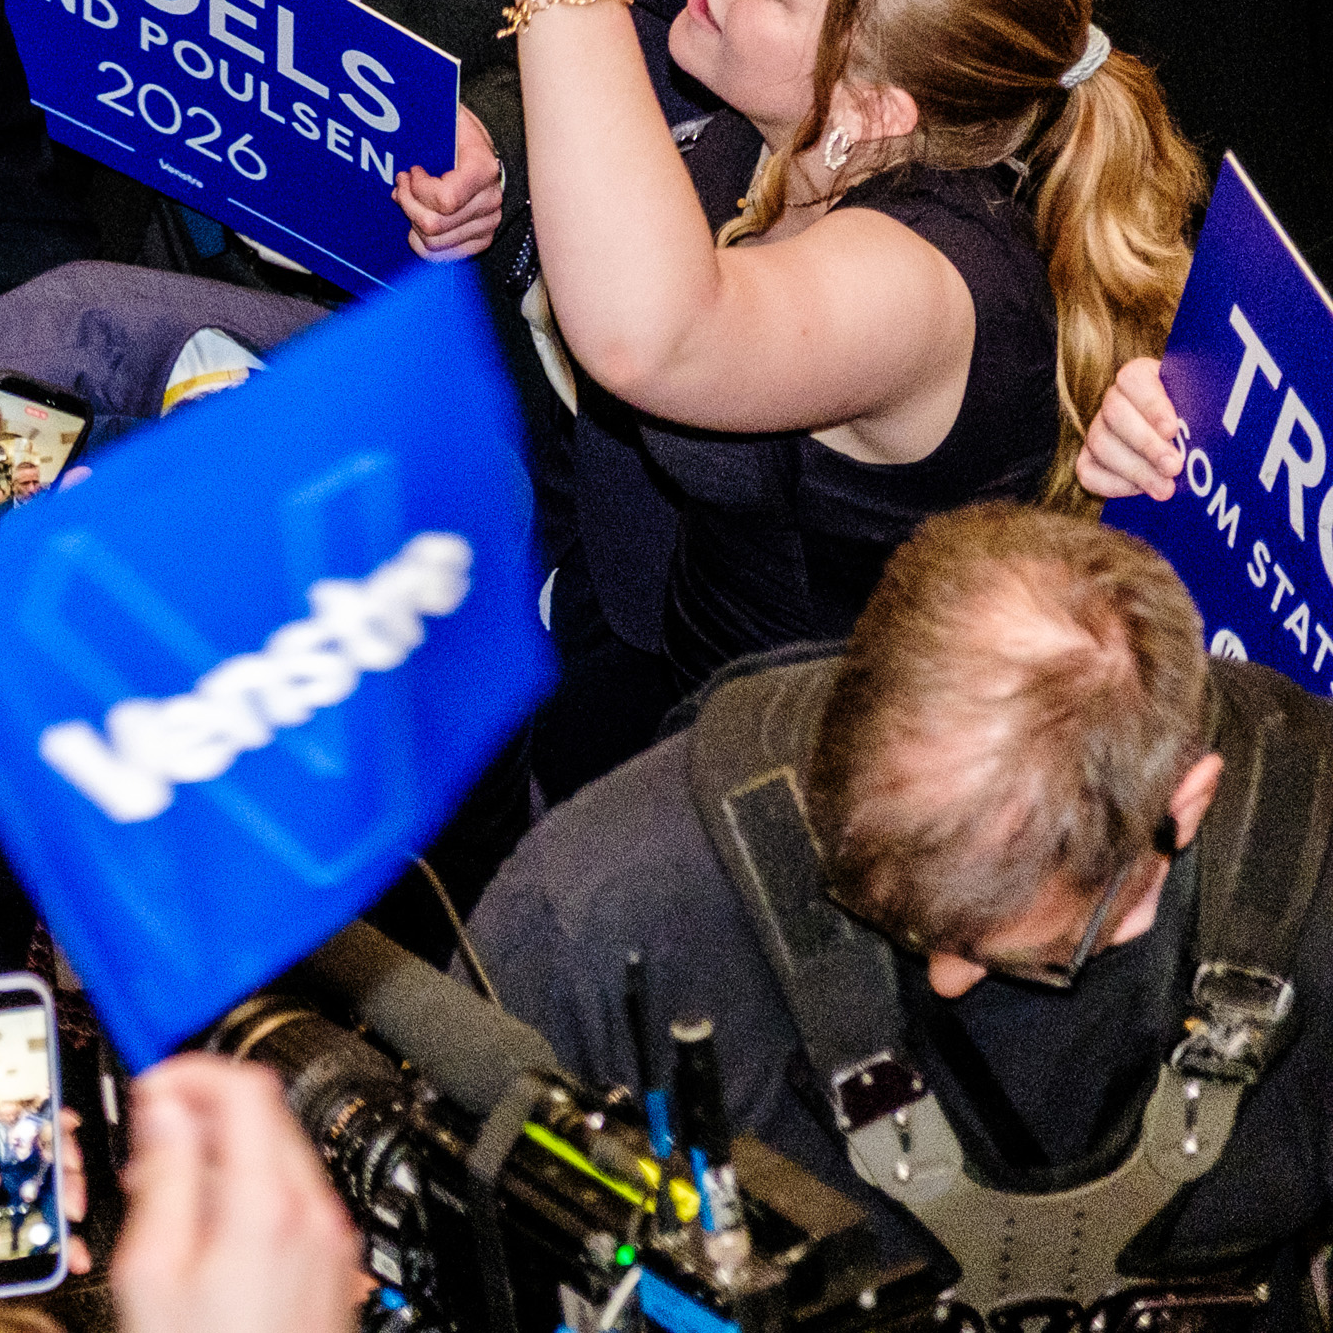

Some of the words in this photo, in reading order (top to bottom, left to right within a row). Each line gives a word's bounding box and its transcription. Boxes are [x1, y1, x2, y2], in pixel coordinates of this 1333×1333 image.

[96, 60, 268, 181] 2026
[140, 17, 395, 186] POULSEN
[1222, 304, 1333, 591] TR
[1247, 540, 1333, 693] STAT
